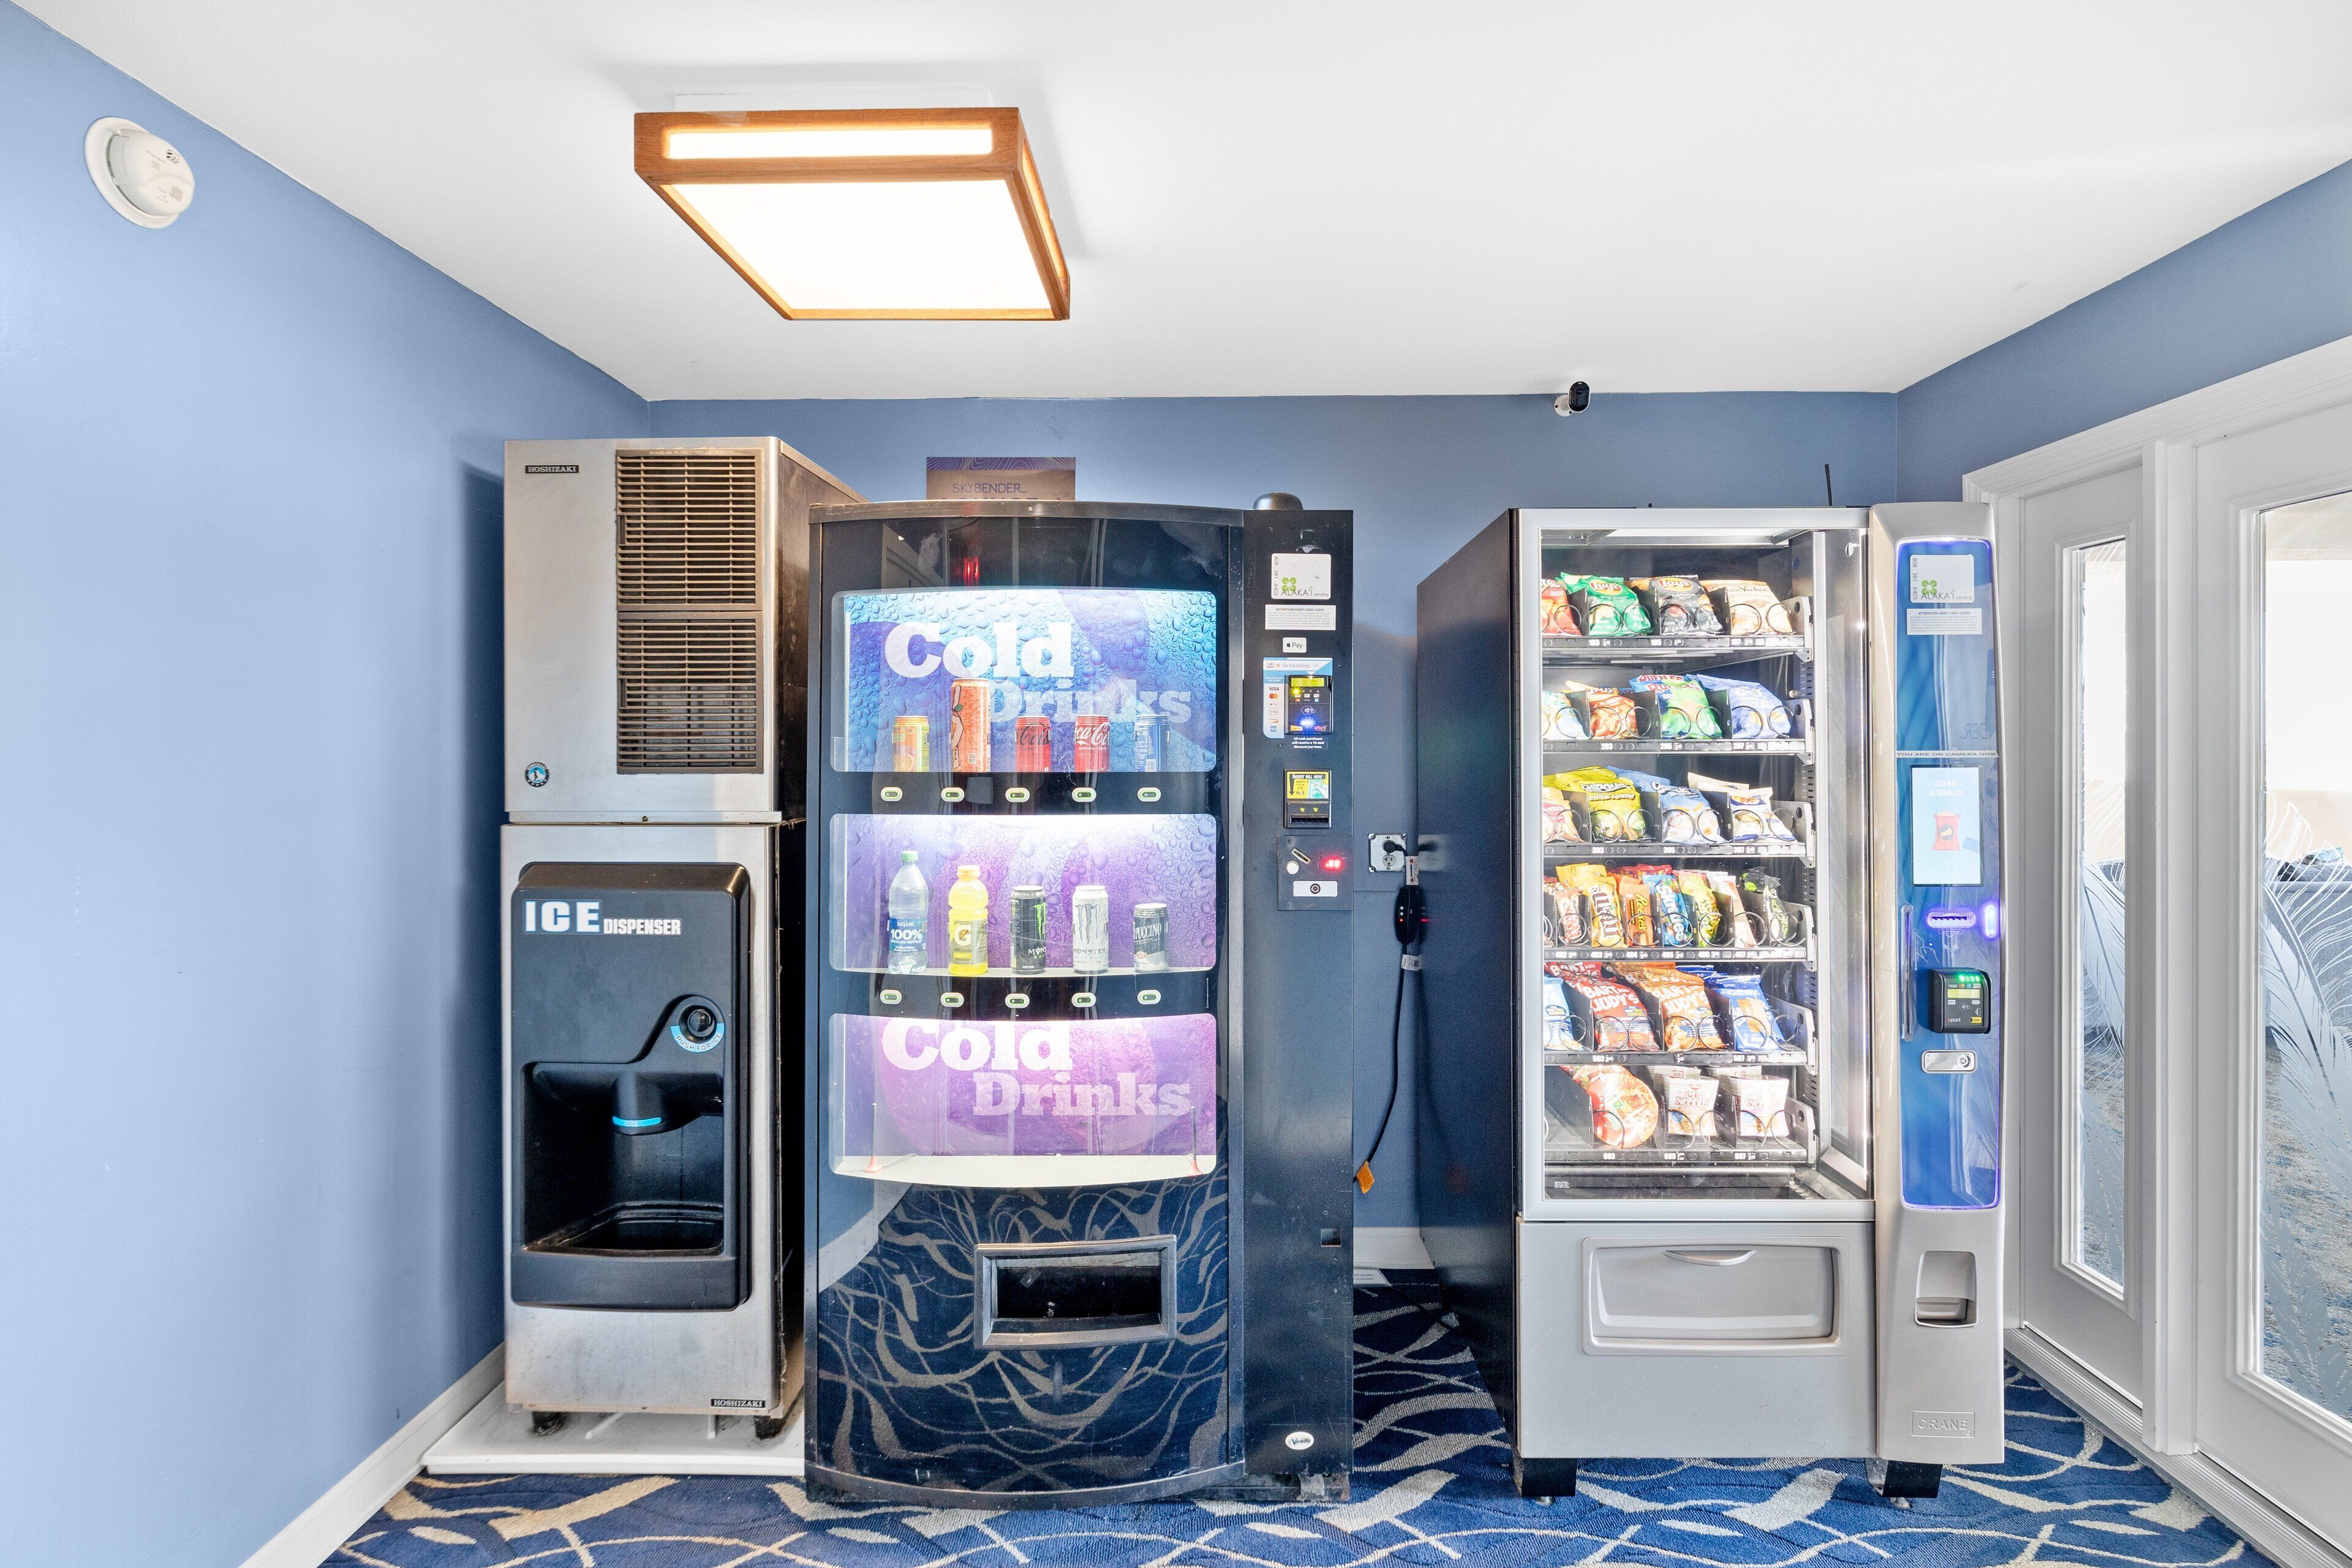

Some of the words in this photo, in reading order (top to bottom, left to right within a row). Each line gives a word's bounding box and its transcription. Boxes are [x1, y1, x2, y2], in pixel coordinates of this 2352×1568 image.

[952, 483, 1027, 493] SKYBENDER
[885, 622, 1074, 678] Cold
[988, 679, 1191, 723] Drinks
[526, 901, 600, 932] ICE
[603, 918, 681, 935] DISPENSER
[891, 929, 922, 940] 100%
[1582, 986, 1618, 998] BART
[1593, 993, 1639, 1011] JUDY'S
[676, 1035, 695, 1050] PUSH
[711, 1033, 721, 1044] ICE
[882, 1019, 1073, 1071] Cold
[973, 1072, 1191, 1117] Drinks
[1918, 1419, 1968, 1430] CRANE
